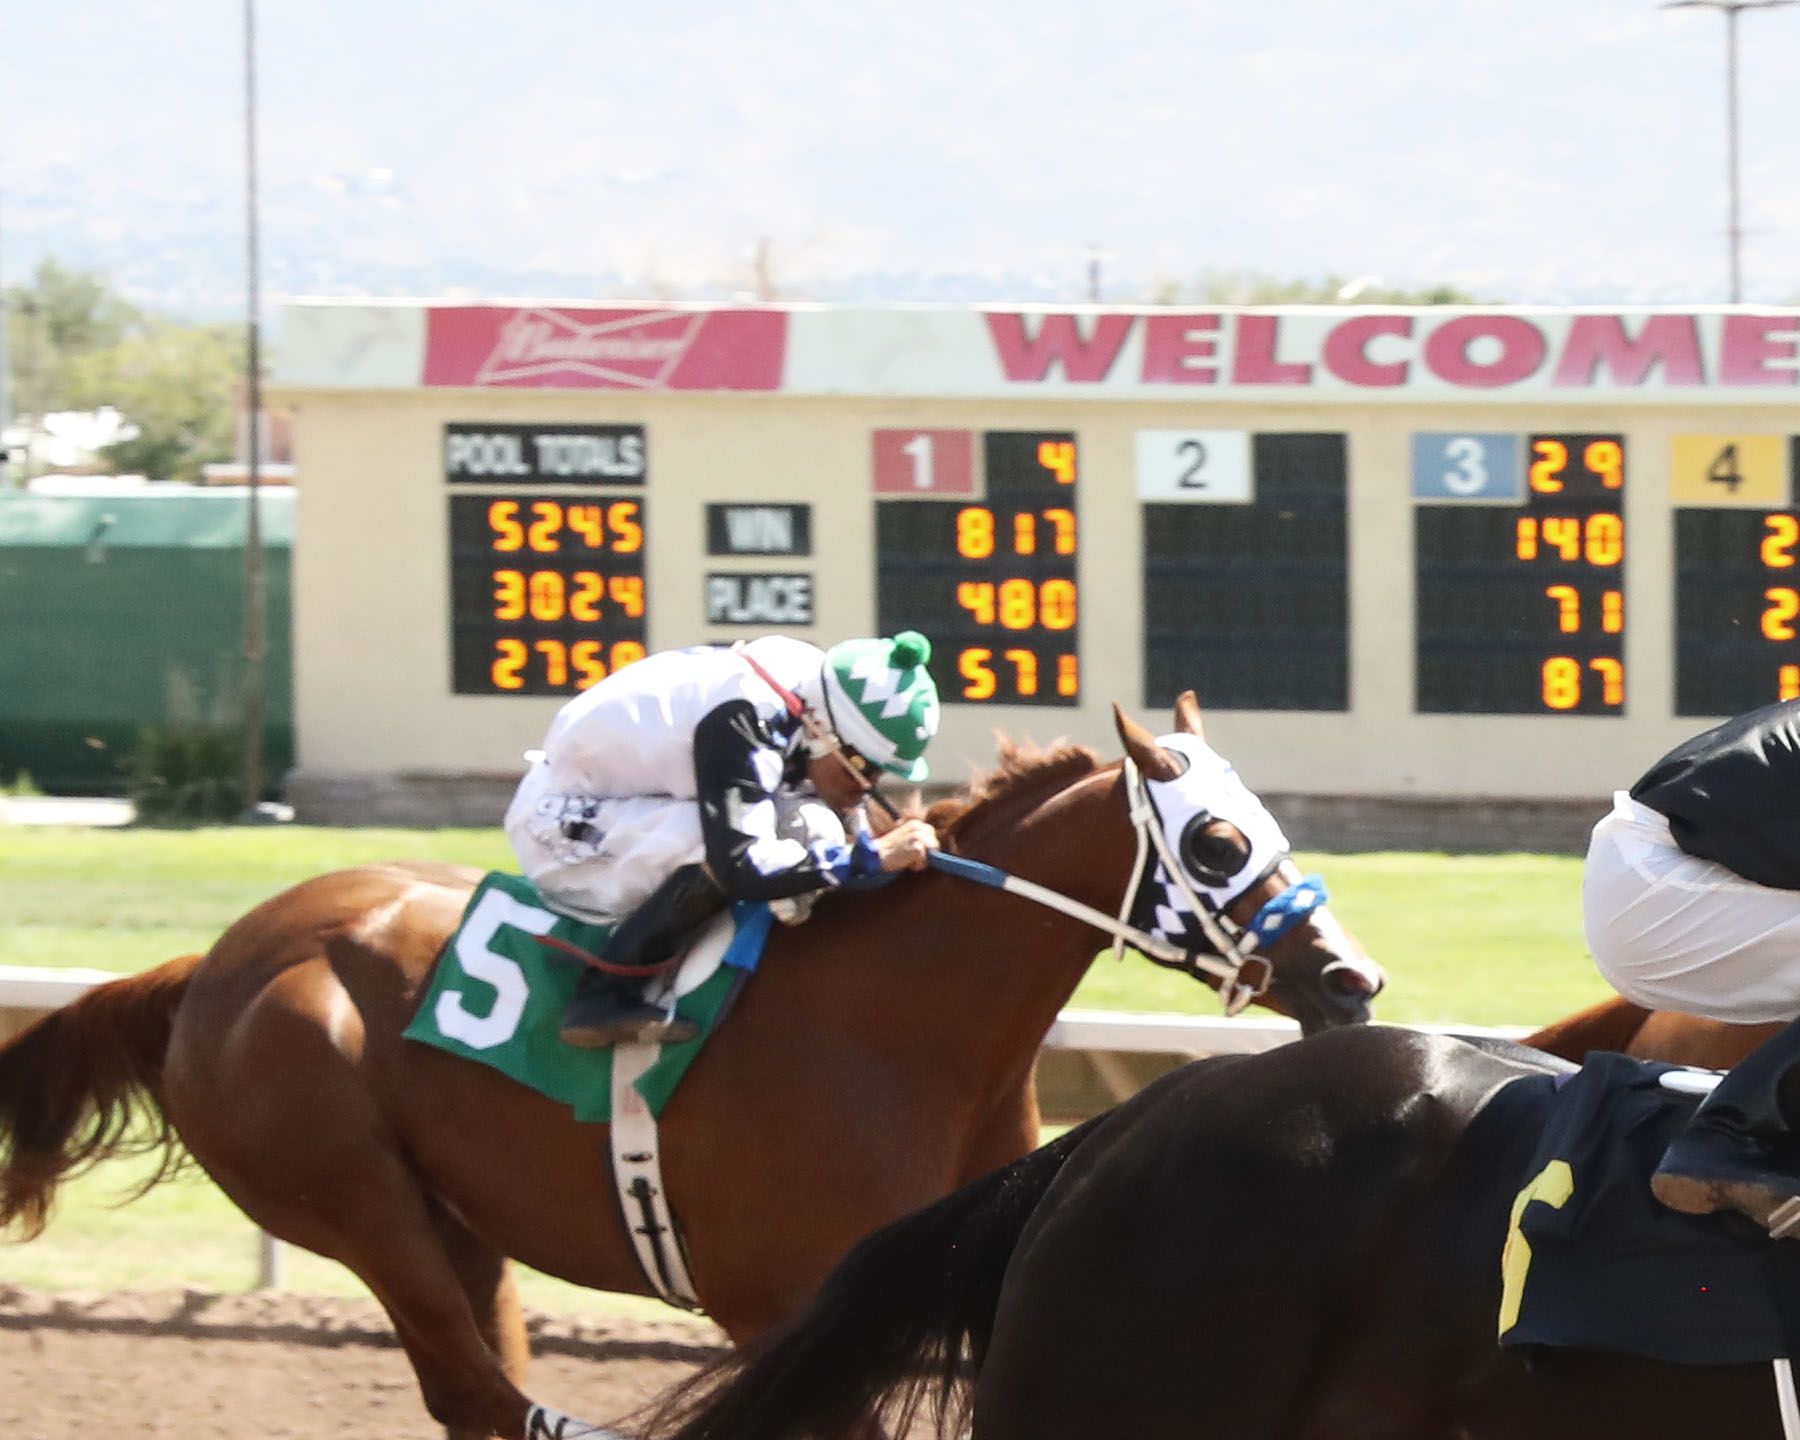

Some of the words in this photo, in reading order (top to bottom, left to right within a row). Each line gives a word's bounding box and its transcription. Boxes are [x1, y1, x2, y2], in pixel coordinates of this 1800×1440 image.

[986, 313, 1800, 385] WELCOME
[446, 433, 531, 476] POOL
[533, 433, 644, 477] TOTALS
[903, 438, 934, 488] 1
[1036, 440, 1078, 486] 4
[1175, 439, 1211, 490] 2
[1444, 438, 1488, 495] 3
[1528, 438, 1625, 495] 29
[1706, 443, 1744, 493] 4
[486, 499, 645, 555] 5245
[724, 507, 795, 552] WIN
[955, 505, 1078, 561] 817
[1515, 511, 1626, 568] 140
[491, 568, 647, 624] 3024
[707, 577, 810, 625] PLACE
[955, 576, 1079, 632] 480
[1544, 583, 1626, 635] 71
[957, 646, 1080, 701] 571
[1540, 655, 1626, 711] 87
[433, 888, 559, 1051] 5
